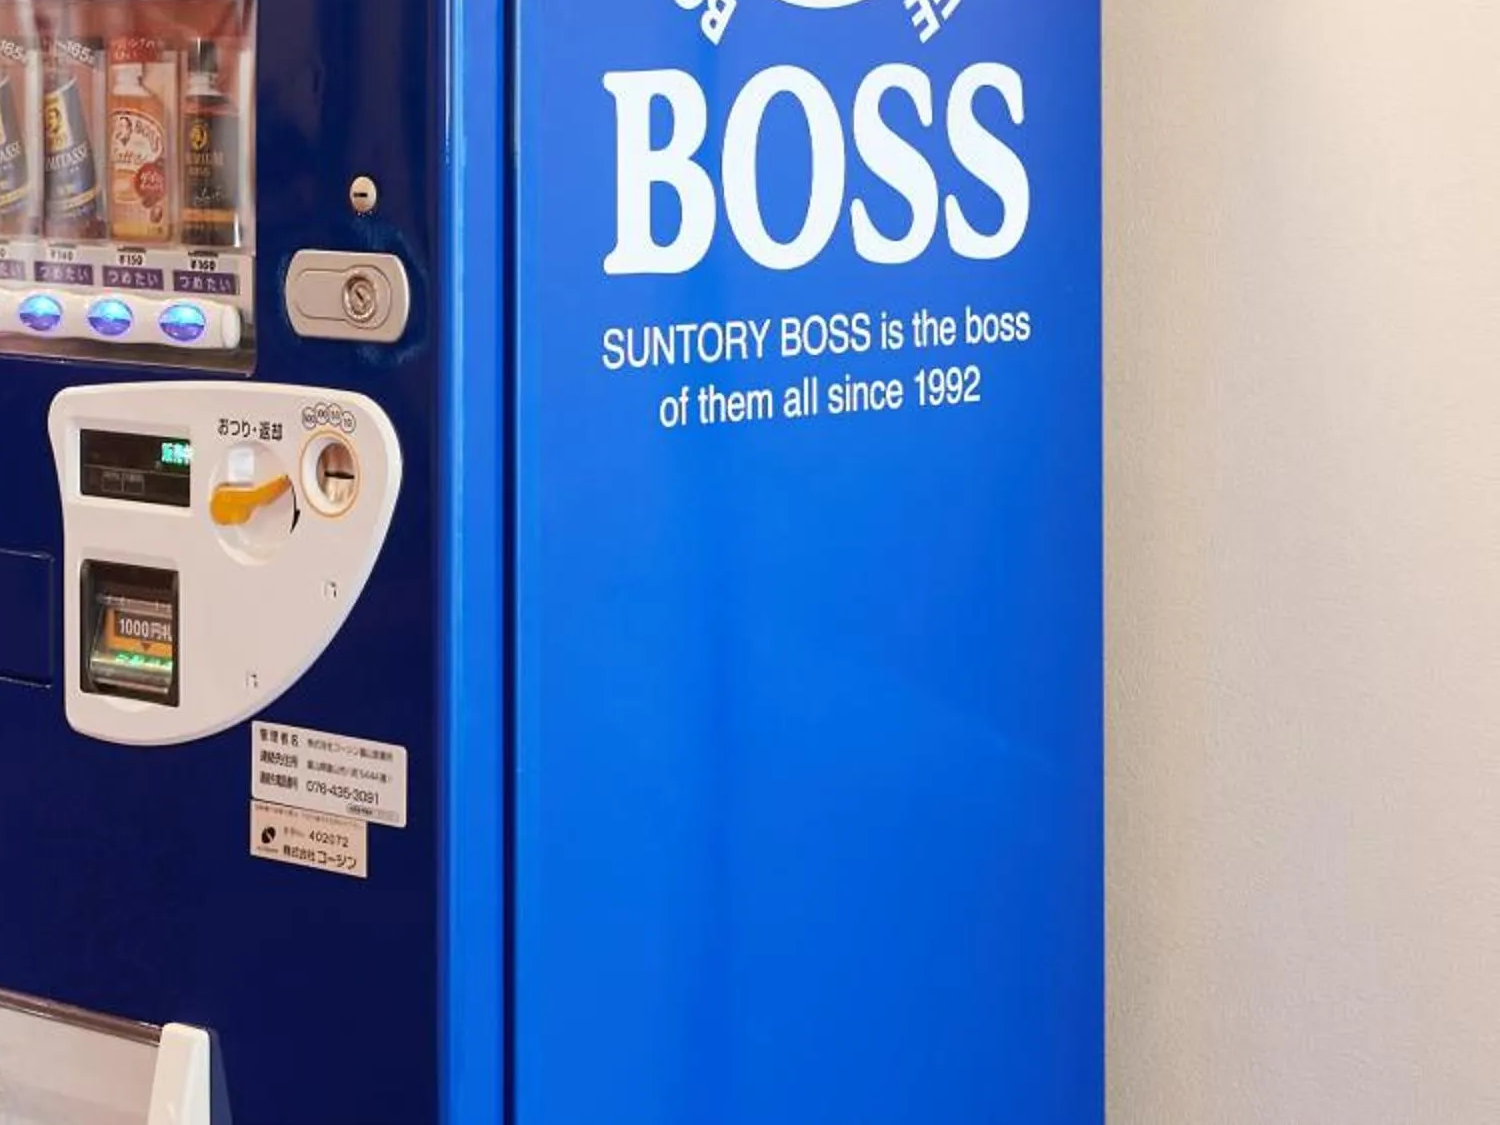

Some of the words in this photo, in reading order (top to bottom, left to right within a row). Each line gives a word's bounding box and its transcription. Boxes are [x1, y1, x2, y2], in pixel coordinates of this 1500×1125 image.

[602, 61, 1030, 275] BOSS
[107, 269, 160, 287] つめたい
[179, 274, 232, 292] つめたい
[602, 319, 771, 370] SUNTORY
[781, 312, 871, 357] BOSS
[880, 311, 904, 351] is
[912, 308, 957, 348] the
[965, 305, 1031, 344] boss
[659, 387, 690, 428] of
[698, 383, 773, 425] them
[783, 376, 818, 417] all
[827, 374, 904, 415] since
[913, 365, 981, 407] 1992
